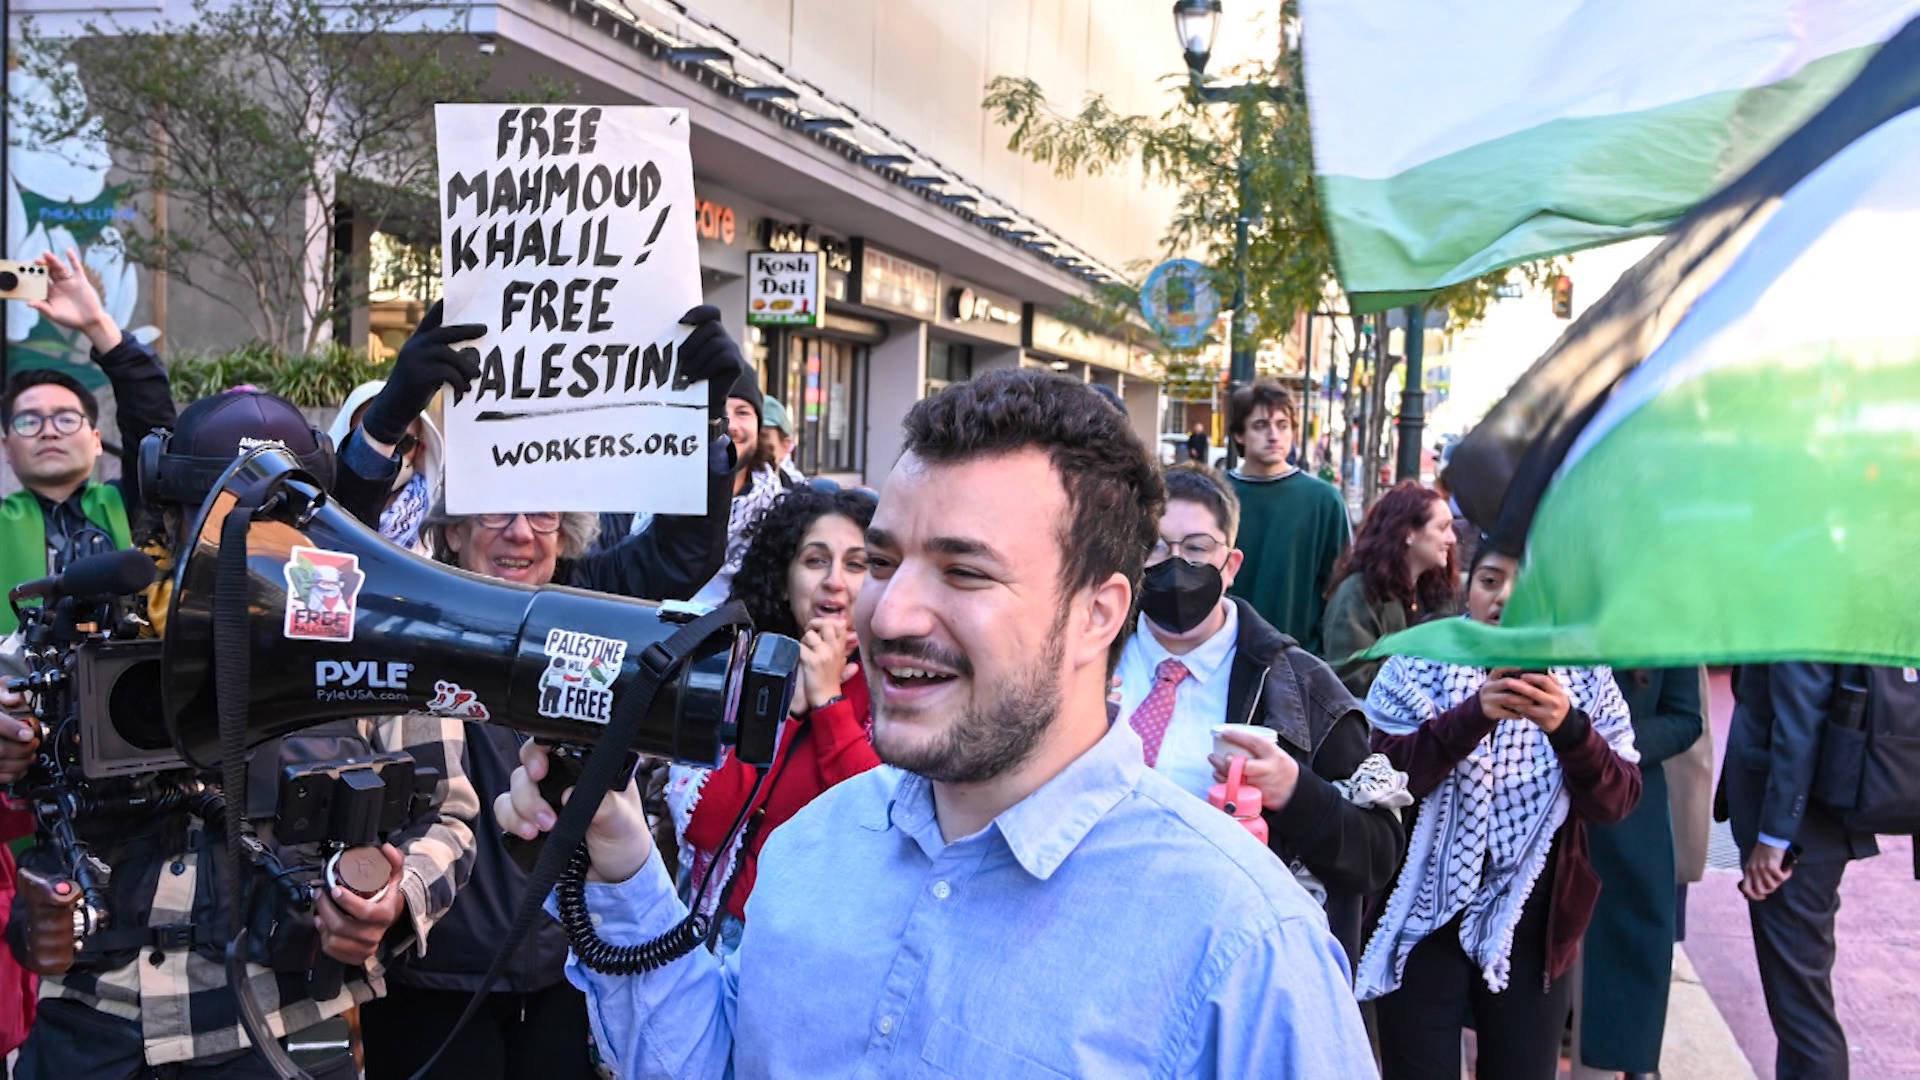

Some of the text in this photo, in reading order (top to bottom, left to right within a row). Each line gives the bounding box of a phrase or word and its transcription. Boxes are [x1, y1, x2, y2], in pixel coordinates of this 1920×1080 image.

[497, 107, 602, 161] FREE
[447, 161, 662, 220] MAHMOUD
[757, 256, 810, 276] Kosh
[758, 278, 806, 296] Deli
[501, 277, 619, 334] FREE
[453, 340, 692, 408] ALESTIN
[492, 433, 699, 467] WORKERS.ORG
[294, 608, 348, 627] FREE
[547, 631, 623, 664] PALESTINE
[315, 660, 409, 689] PYLE
[316, 689, 409, 702] PyleUSA.com
[564, 686, 609, 720] FREE
